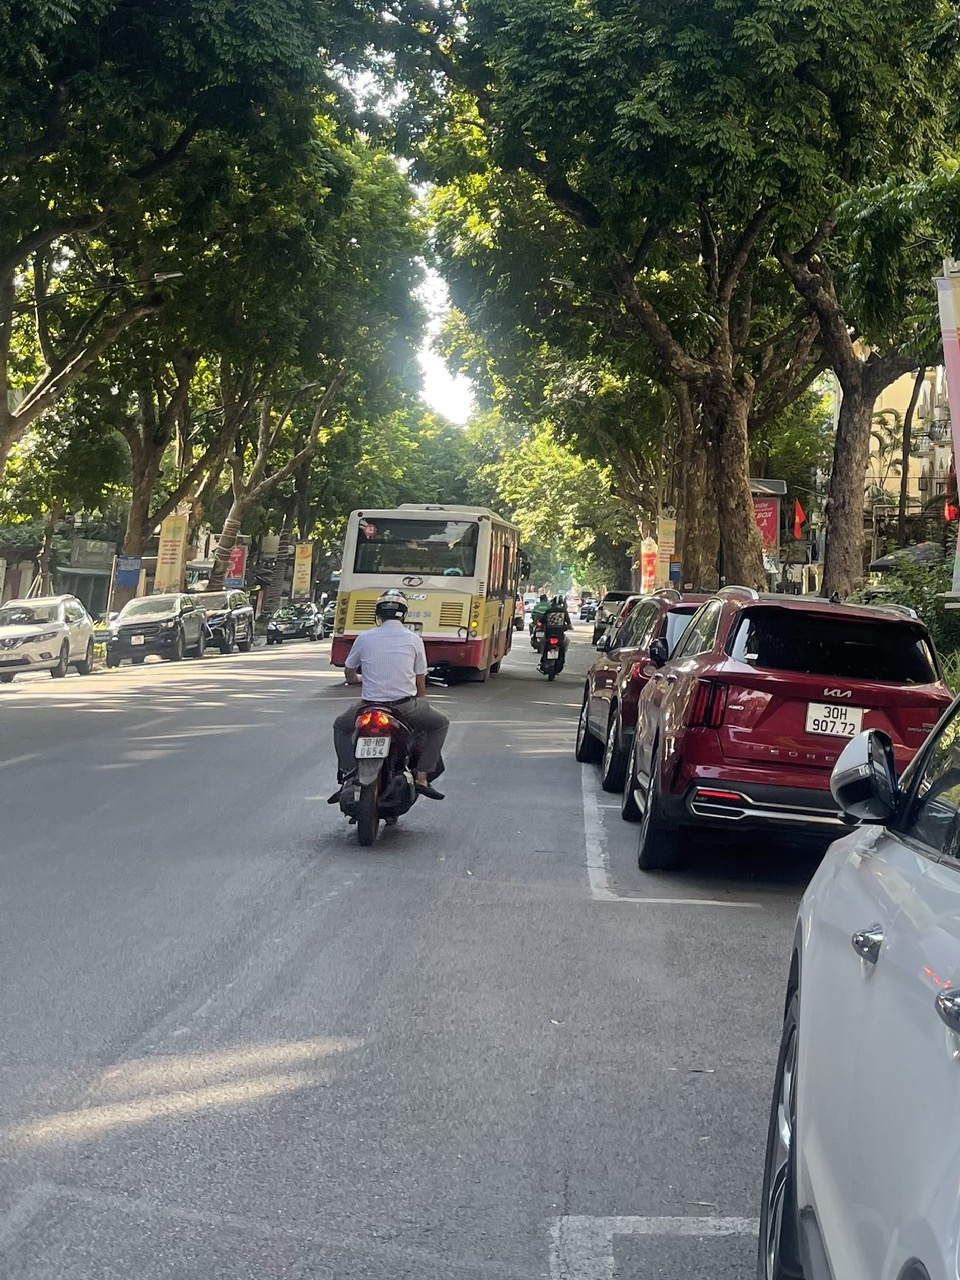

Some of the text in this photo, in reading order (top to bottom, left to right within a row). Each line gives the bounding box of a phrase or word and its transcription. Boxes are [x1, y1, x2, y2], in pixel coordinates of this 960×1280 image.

[823, 687, 852, 698] KIA
[823, 706, 848, 720] 30H
[812, 719, 855, 736] 907.72
[770, 748, 835, 762] SORE
